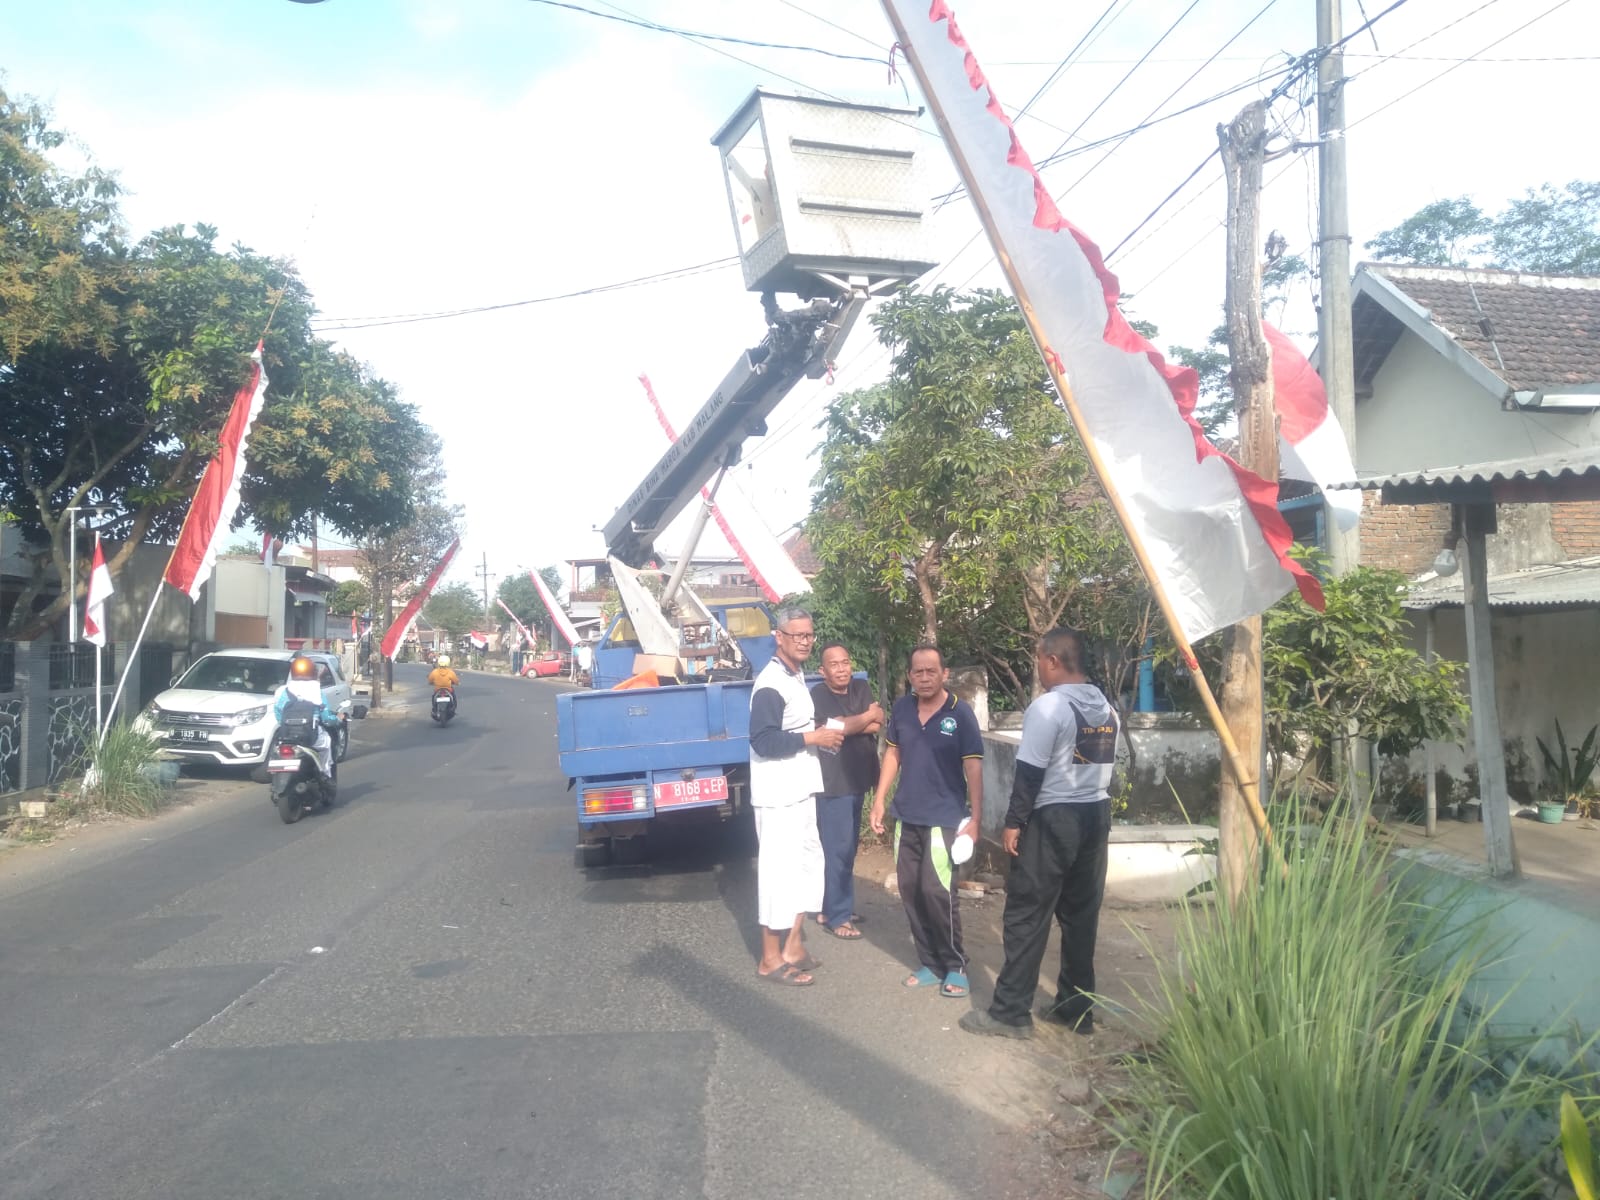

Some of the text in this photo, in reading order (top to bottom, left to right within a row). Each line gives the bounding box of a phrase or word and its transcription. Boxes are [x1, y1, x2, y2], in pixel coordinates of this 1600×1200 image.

[696, 391, 724, 432] MALANG
[653, 778, 725, 800] N 8168 EP
